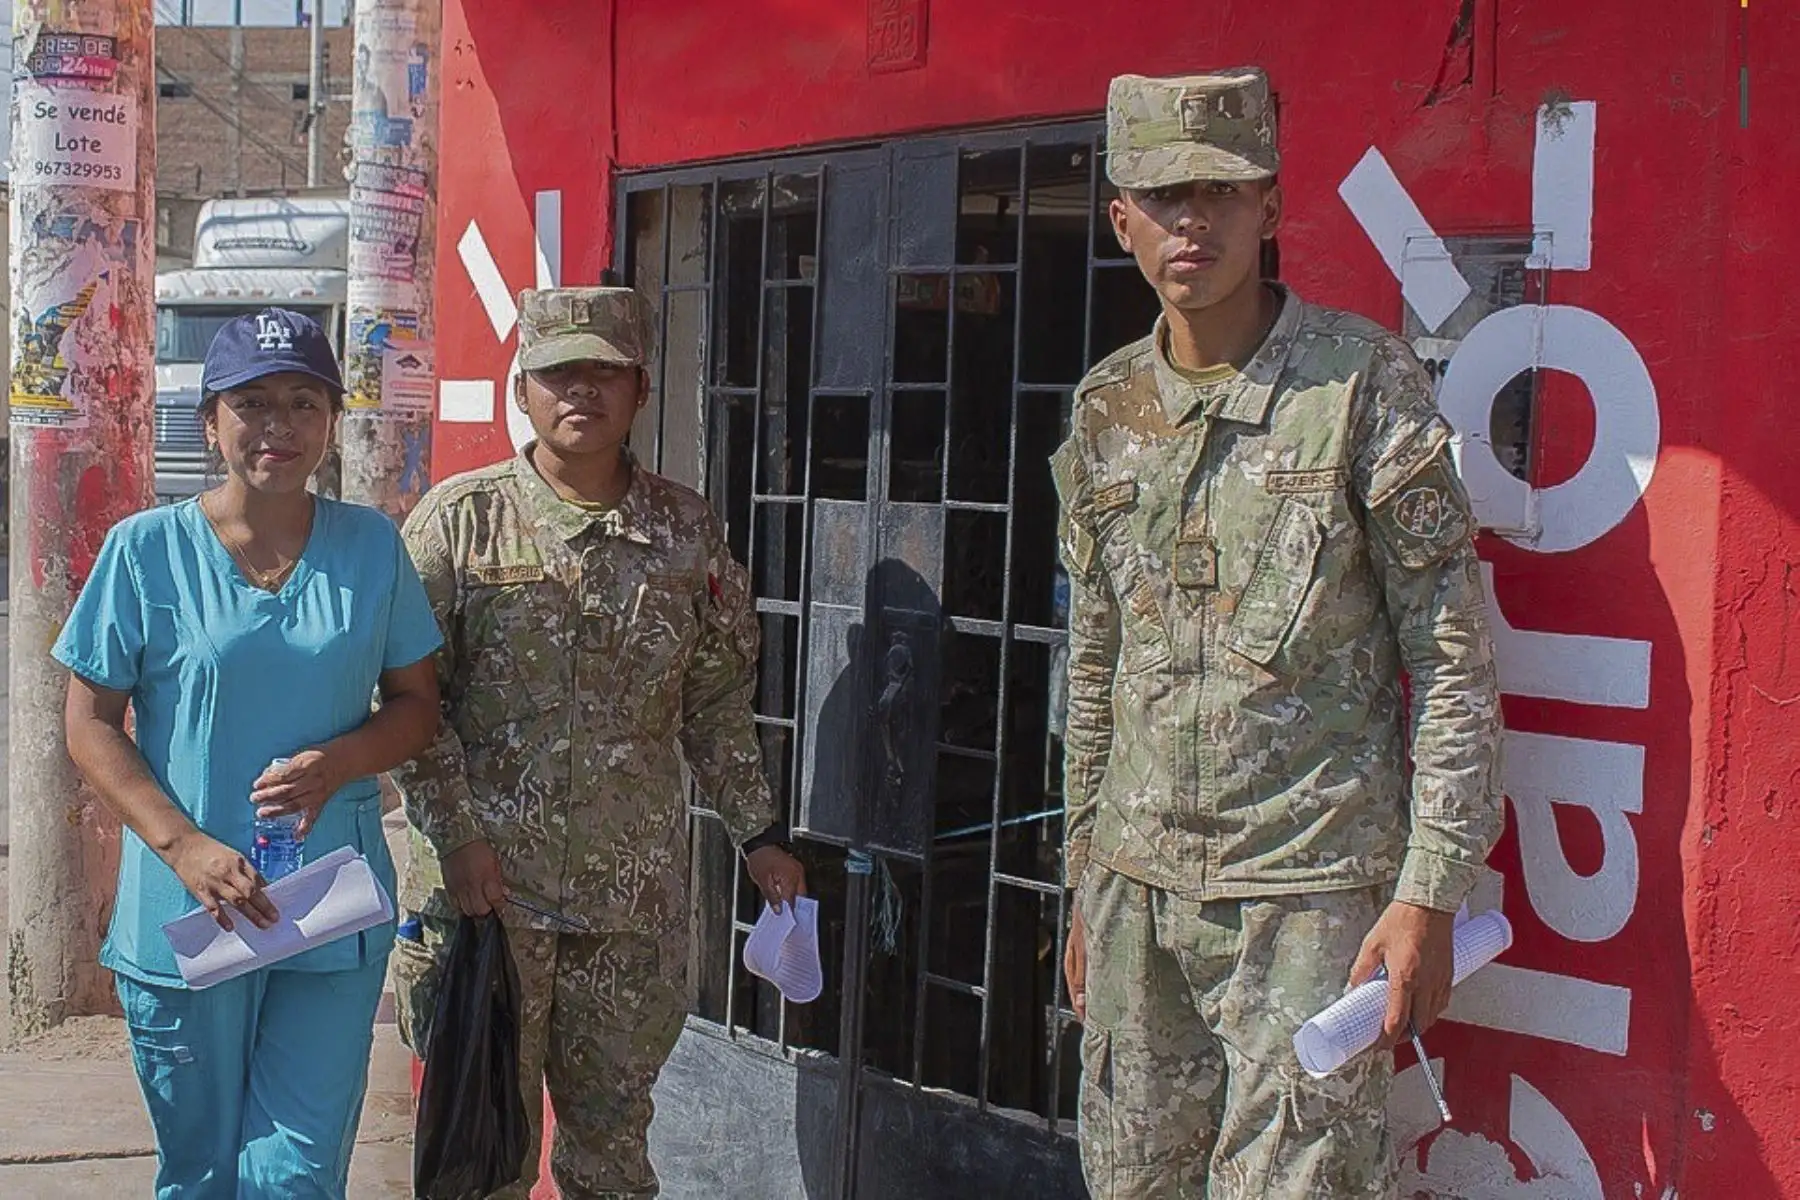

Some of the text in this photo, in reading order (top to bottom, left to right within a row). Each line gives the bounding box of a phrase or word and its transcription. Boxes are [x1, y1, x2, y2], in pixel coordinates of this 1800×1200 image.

[34, 102, 127, 125] Se vendé
[55, 132, 103, 154] Lote
[35, 161, 122, 180] 967329953
[255, 314, 293, 350] LA
